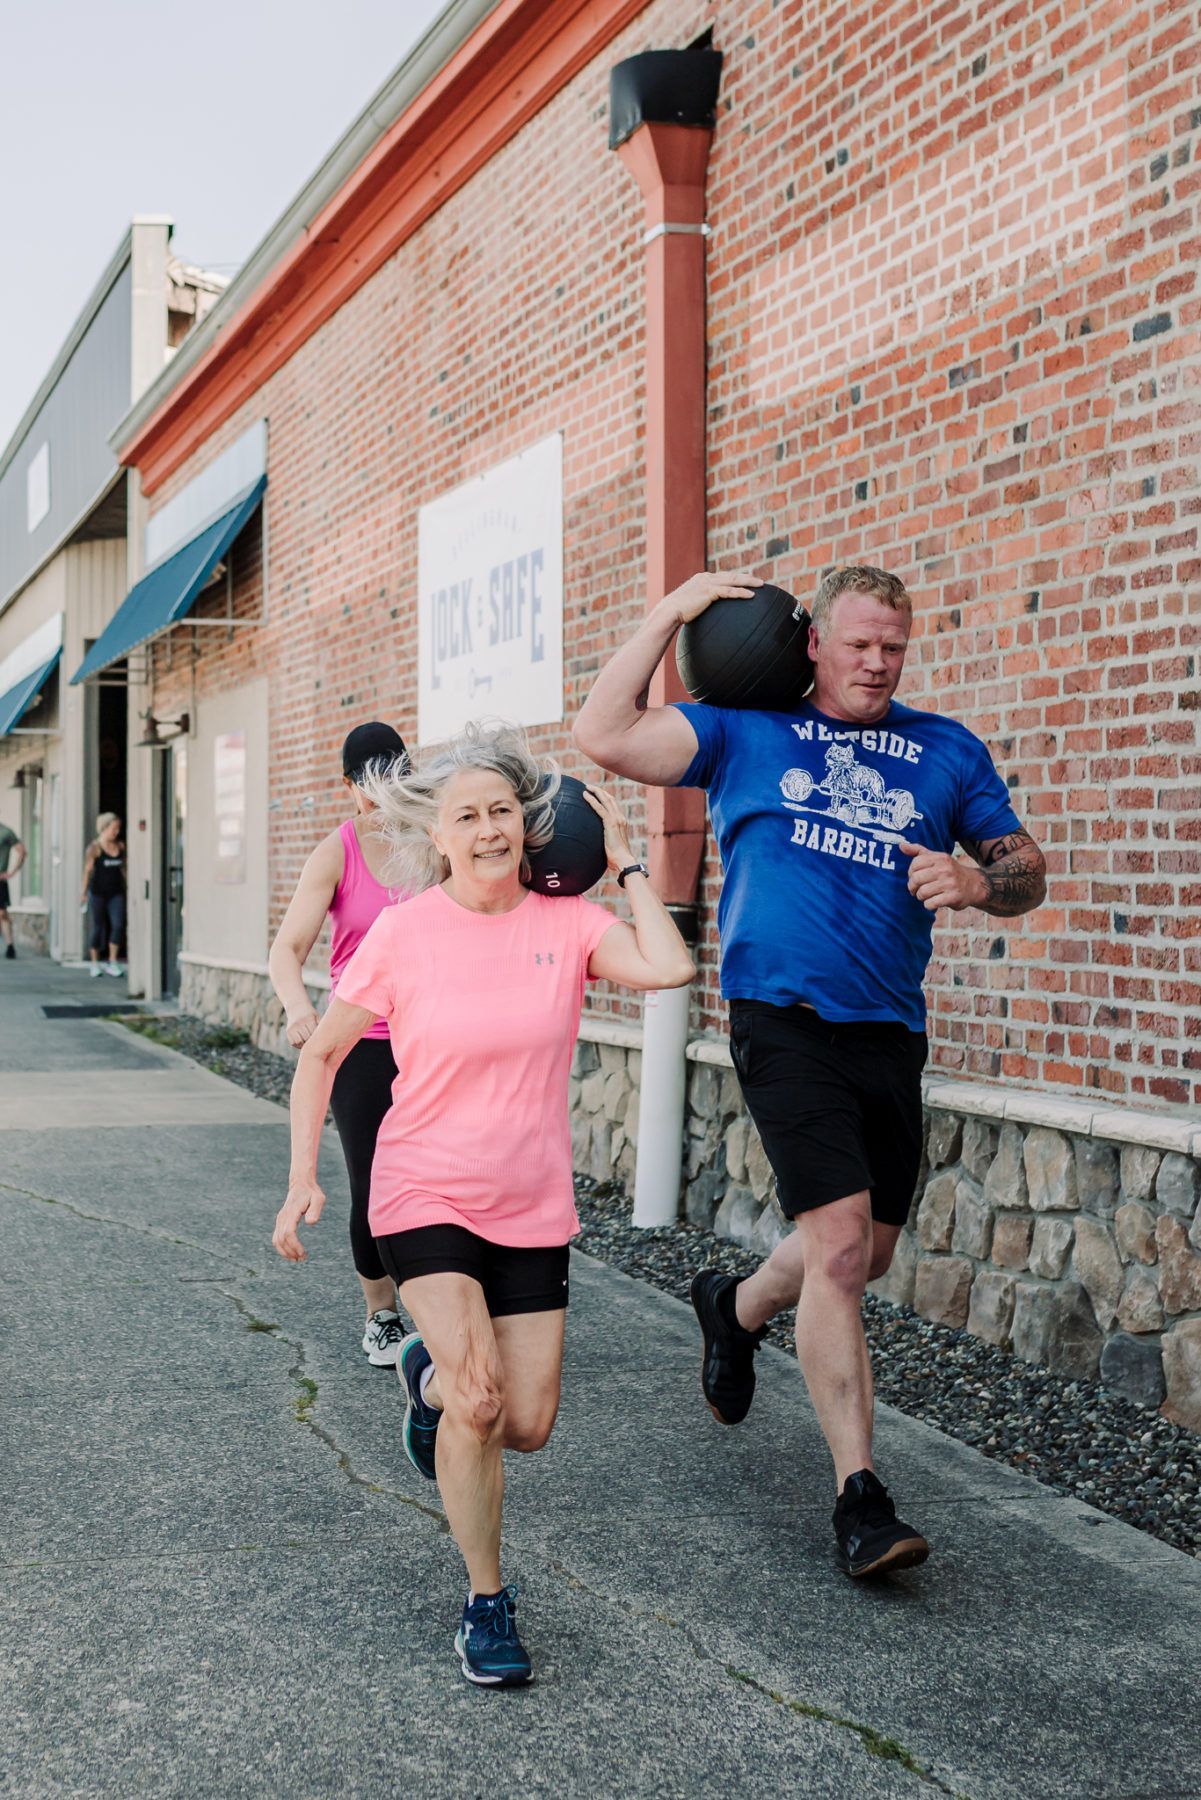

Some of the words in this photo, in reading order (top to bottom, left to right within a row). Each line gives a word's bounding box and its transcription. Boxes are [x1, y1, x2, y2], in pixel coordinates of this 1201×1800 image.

[431, 577, 473, 690] LOCK
[489, 546, 544, 663] SAFE
[790, 818, 896, 870] BARBELL
[545, 872, 560, 888] 10
